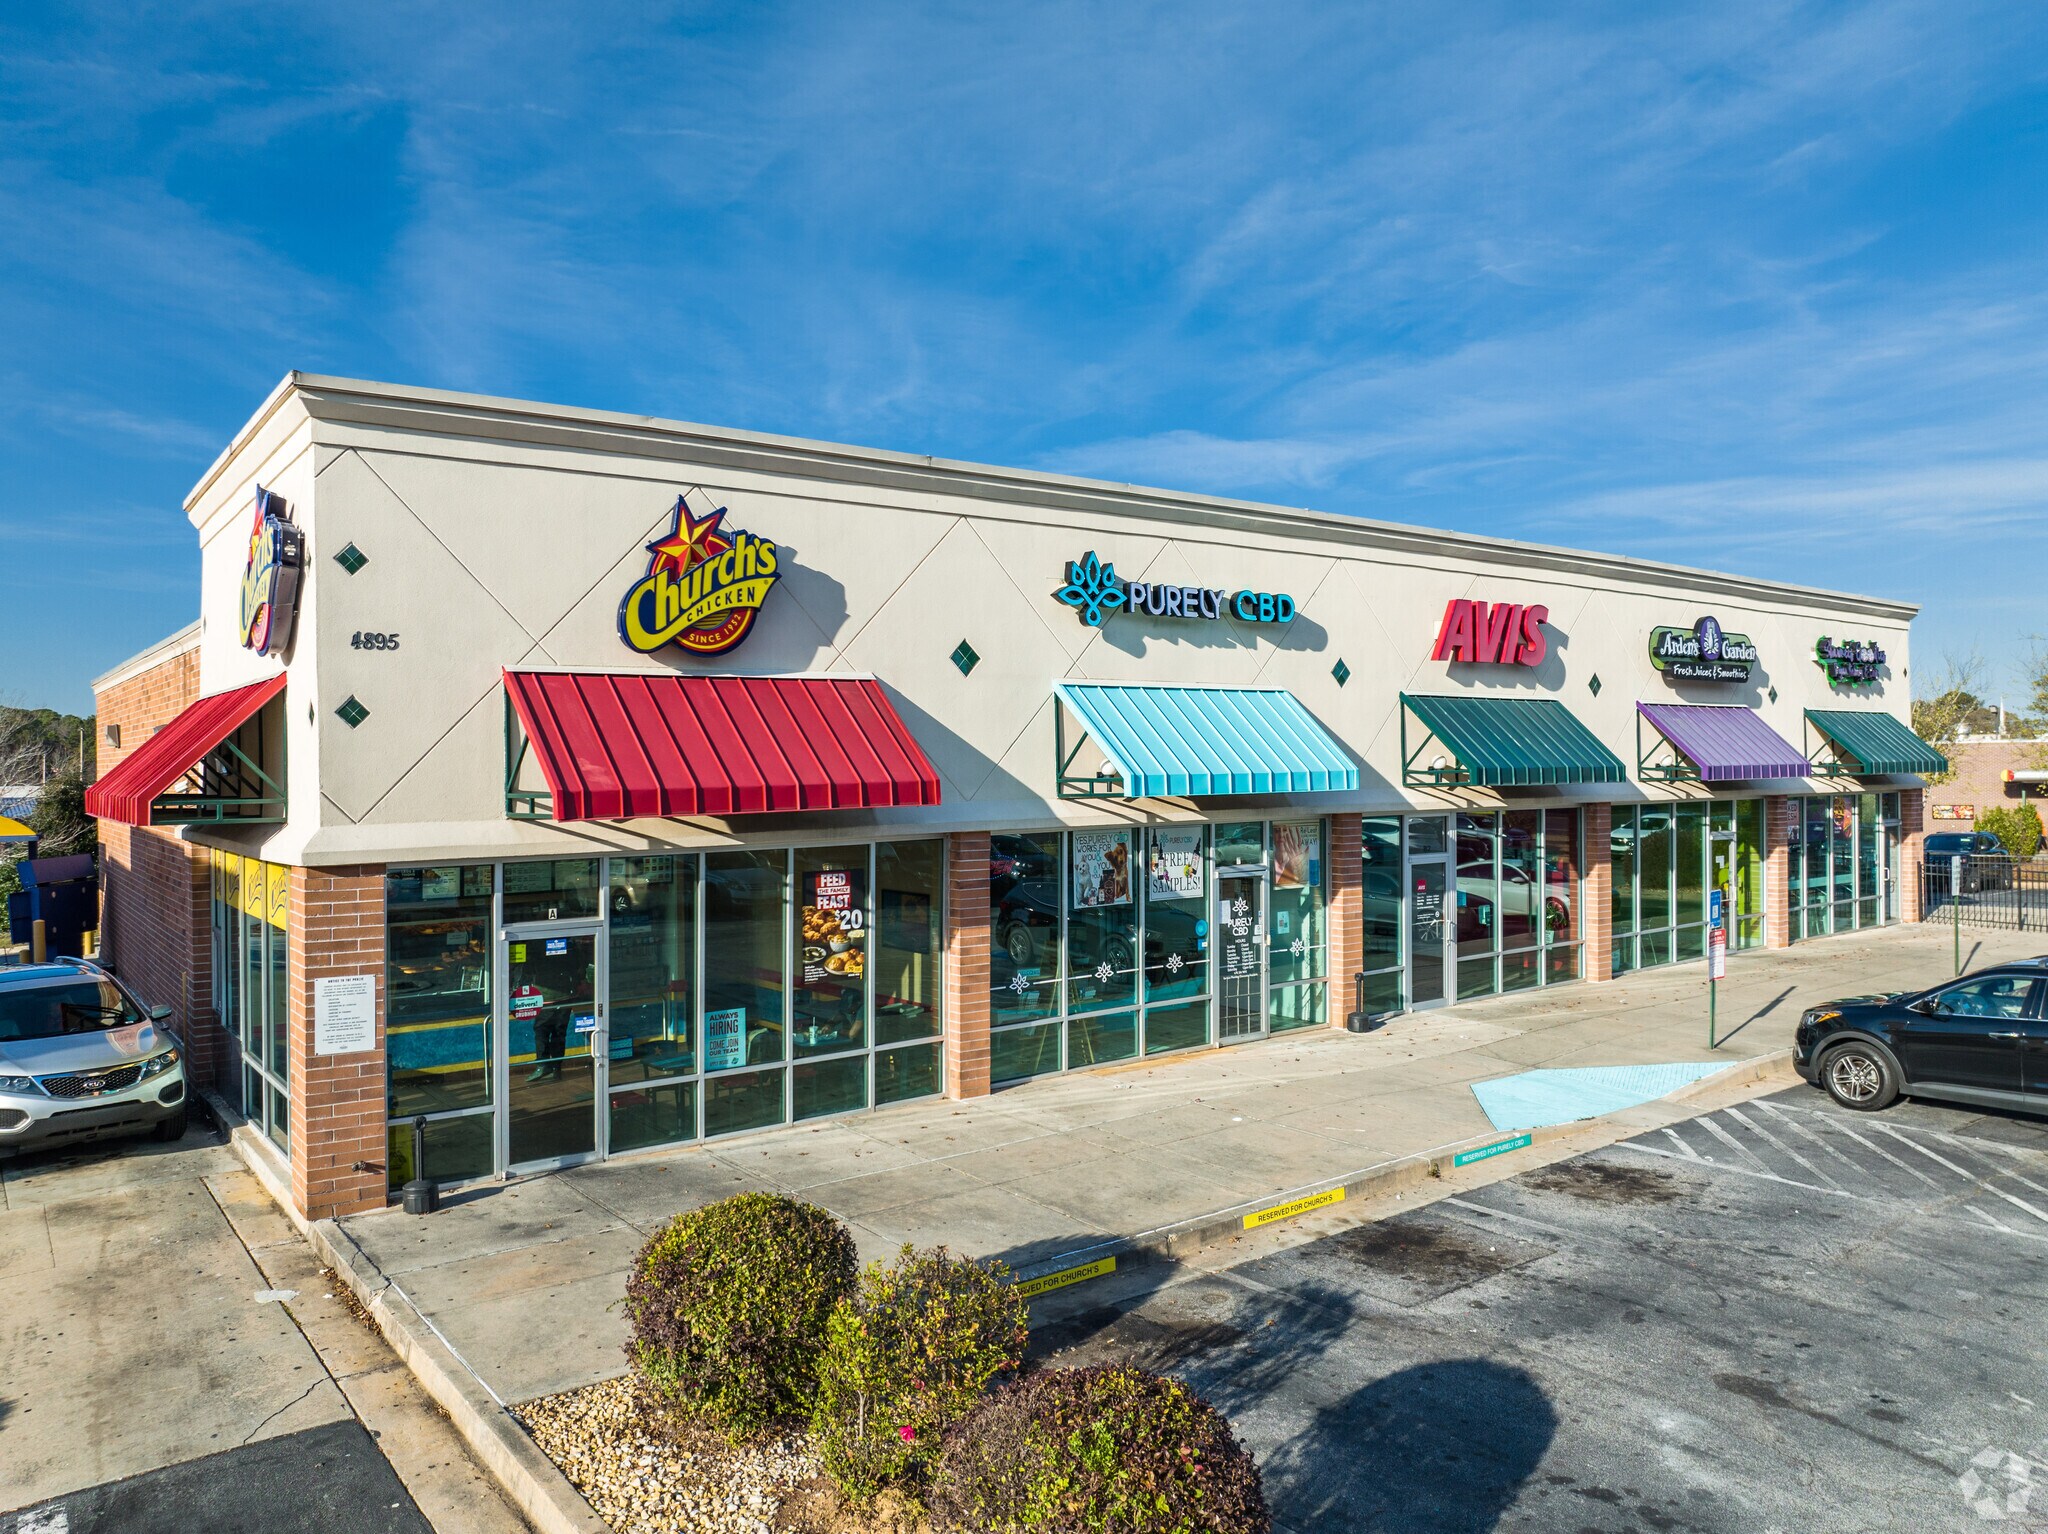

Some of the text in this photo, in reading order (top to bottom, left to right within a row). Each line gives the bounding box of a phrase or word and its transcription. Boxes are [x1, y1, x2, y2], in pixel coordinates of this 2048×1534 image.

[625, 533, 777, 650] Church's
[686, 586, 755, 622] CHICKEN
[1124, 582, 1295, 623] PURELY CBD
[688, 614, 742, 643] SINCE 1952
[1431, 599, 1549, 666] AVIS
[351, 631, 400, 651] 4895
[1660, 632, 1756, 660] Arden's Garden
[1673, 664, 1692, 676] Fresh
[1692, 665, 1712, 678] Juices
[1717, 667, 1747, 679] Smoothies
[1088, 834, 1113, 844] PURELY
[1076, 843, 1112, 853] WORKS FOR
[1163, 852, 1190, 867] FREE
[820, 873, 846, 887] FEED
[1152, 877, 1201, 893] SAMPLES!
[817, 895, 850, 910] FEAST
[549, 909, 557, 918] A
[834, 909, 863, 930] $20
[1228, 917, 1253, 928] PURELY
[1232, 926, 1249, 936] CBD
[514, 1000, 538, 1008] delivers!
[709, 1012, 738, 1021] ALWAYS
[710, 1019, 738, 1036] HIRING
[710, 1038, 739, 1050] COME JOIN
[1462, 1151, 1487, 1162] RESERVED
[1487, 1147, 1497, 1155] FOR
[1497, 1142, 1514, 1152] PURELY
[1258, 1194, 1333, 1222] RESERVED FOR CHURCH'S
[1043, 1276, 1059, 1288] FOR
[1060, 1265, 1099, 1283] CHURCH'S
